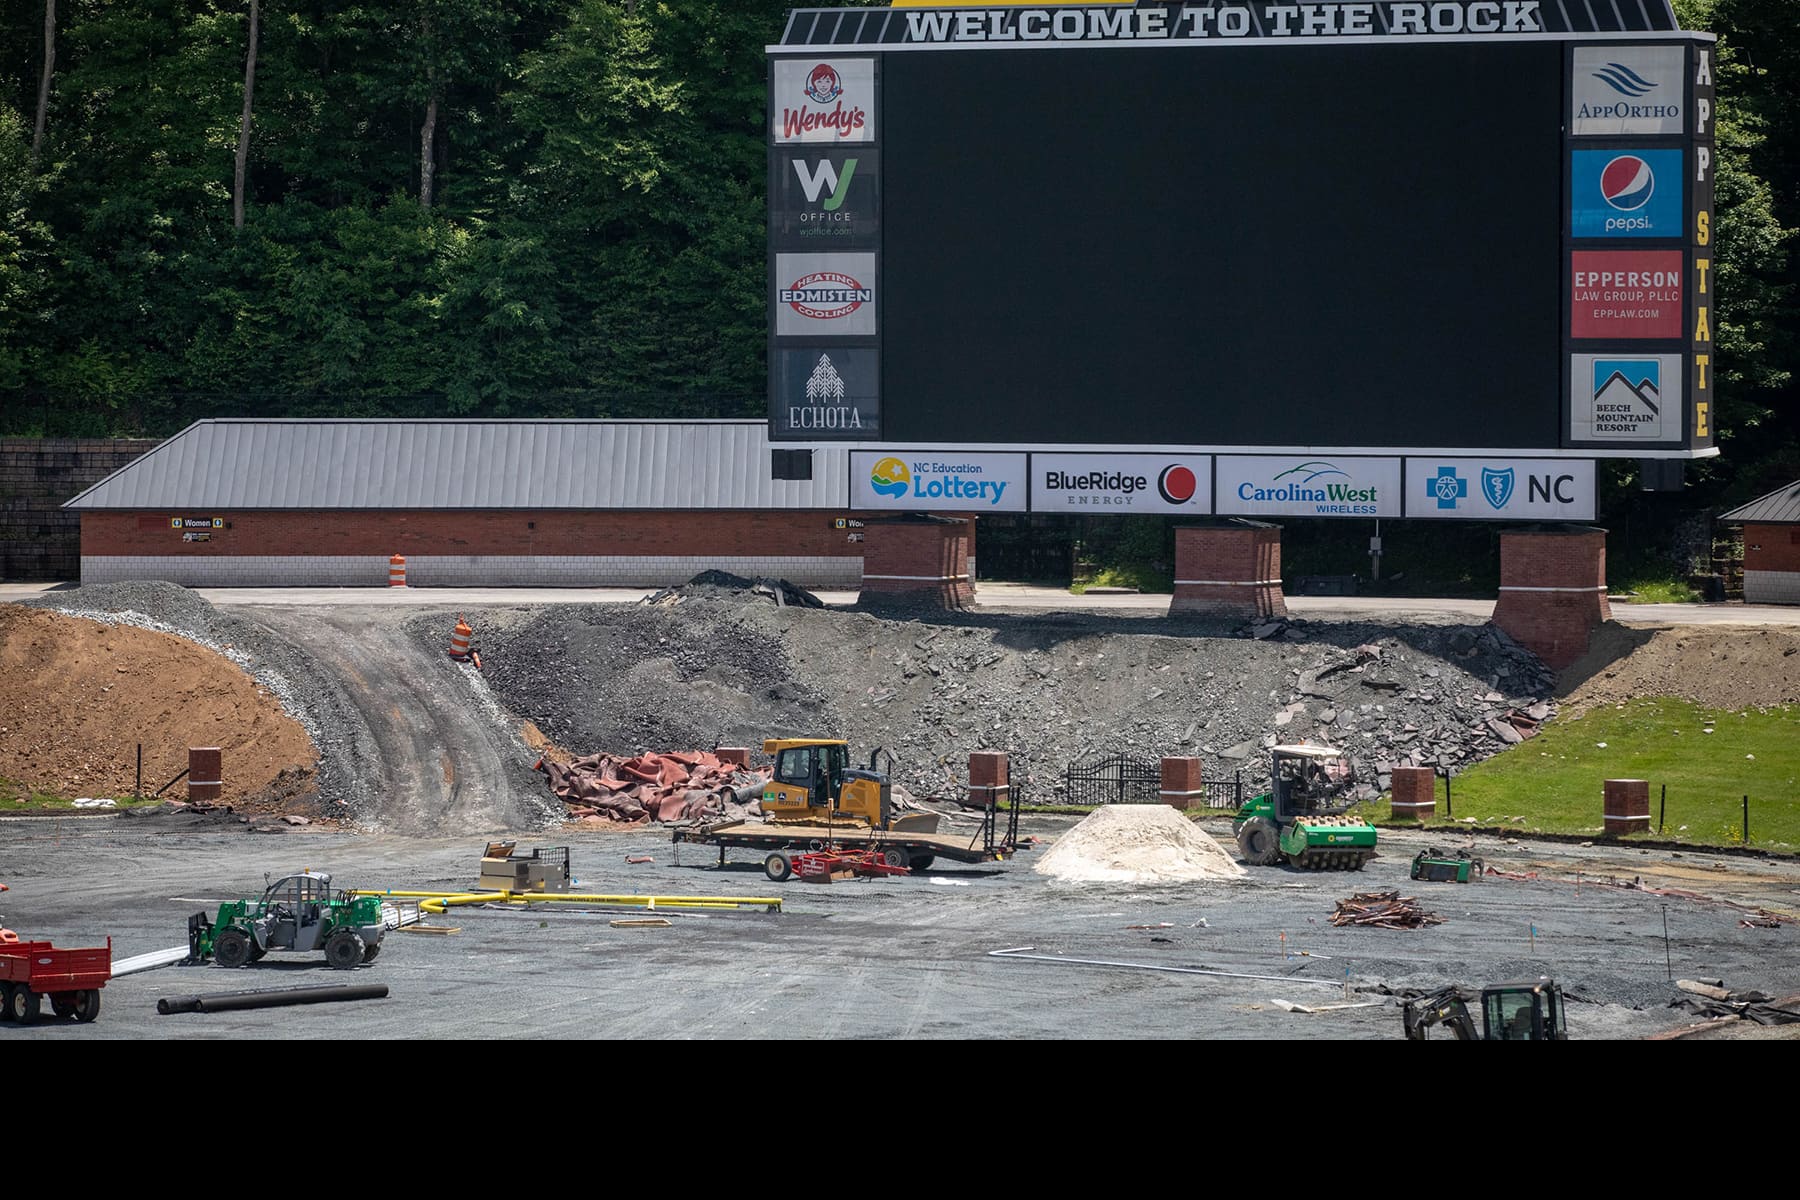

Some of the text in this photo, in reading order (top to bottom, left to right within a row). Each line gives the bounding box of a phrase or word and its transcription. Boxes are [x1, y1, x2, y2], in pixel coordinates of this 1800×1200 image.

[906, 1, 1541, 41] WELCOME TO THE ROCK
[783, 100, 865, 138] Wendy's
[800, 212, 851, 222] OFFICE
[1605, 216, 1650, 232] pepsi
[797, 273, 855, 288] HEATING
[1575, 272, 1679, 287] EPPERSON
[781, 290, 871, 302] EDMISTEN
[1575, 291, 1679, 303] LAW GROUP, PLLC
[797, 305, 855, 318] COOLING
[1593, 309, 1660, 319] EPPLAW.COM
[1596, 404, 1631, 412] BEECH
[789, 406, 862, 428] ECHOTA
[1596, 414, 1654, 422] MOUNTAIN
[1596, 424, 1638, 432] RESORT
[913, 463, 983, 473] NC Education
[1046, 471, 1147, 493] BlueRidge
[914, 475, 1007, 505] Lottery
[1238, 482, 1377, 502] CarolinaWest
[1528, 474, 1575, 504] NC
[1067, 496, 1134, 505] ENERGY
[1316, 505, 1377, 514] WIRELESS
[184, 519, 211, 527] Women
